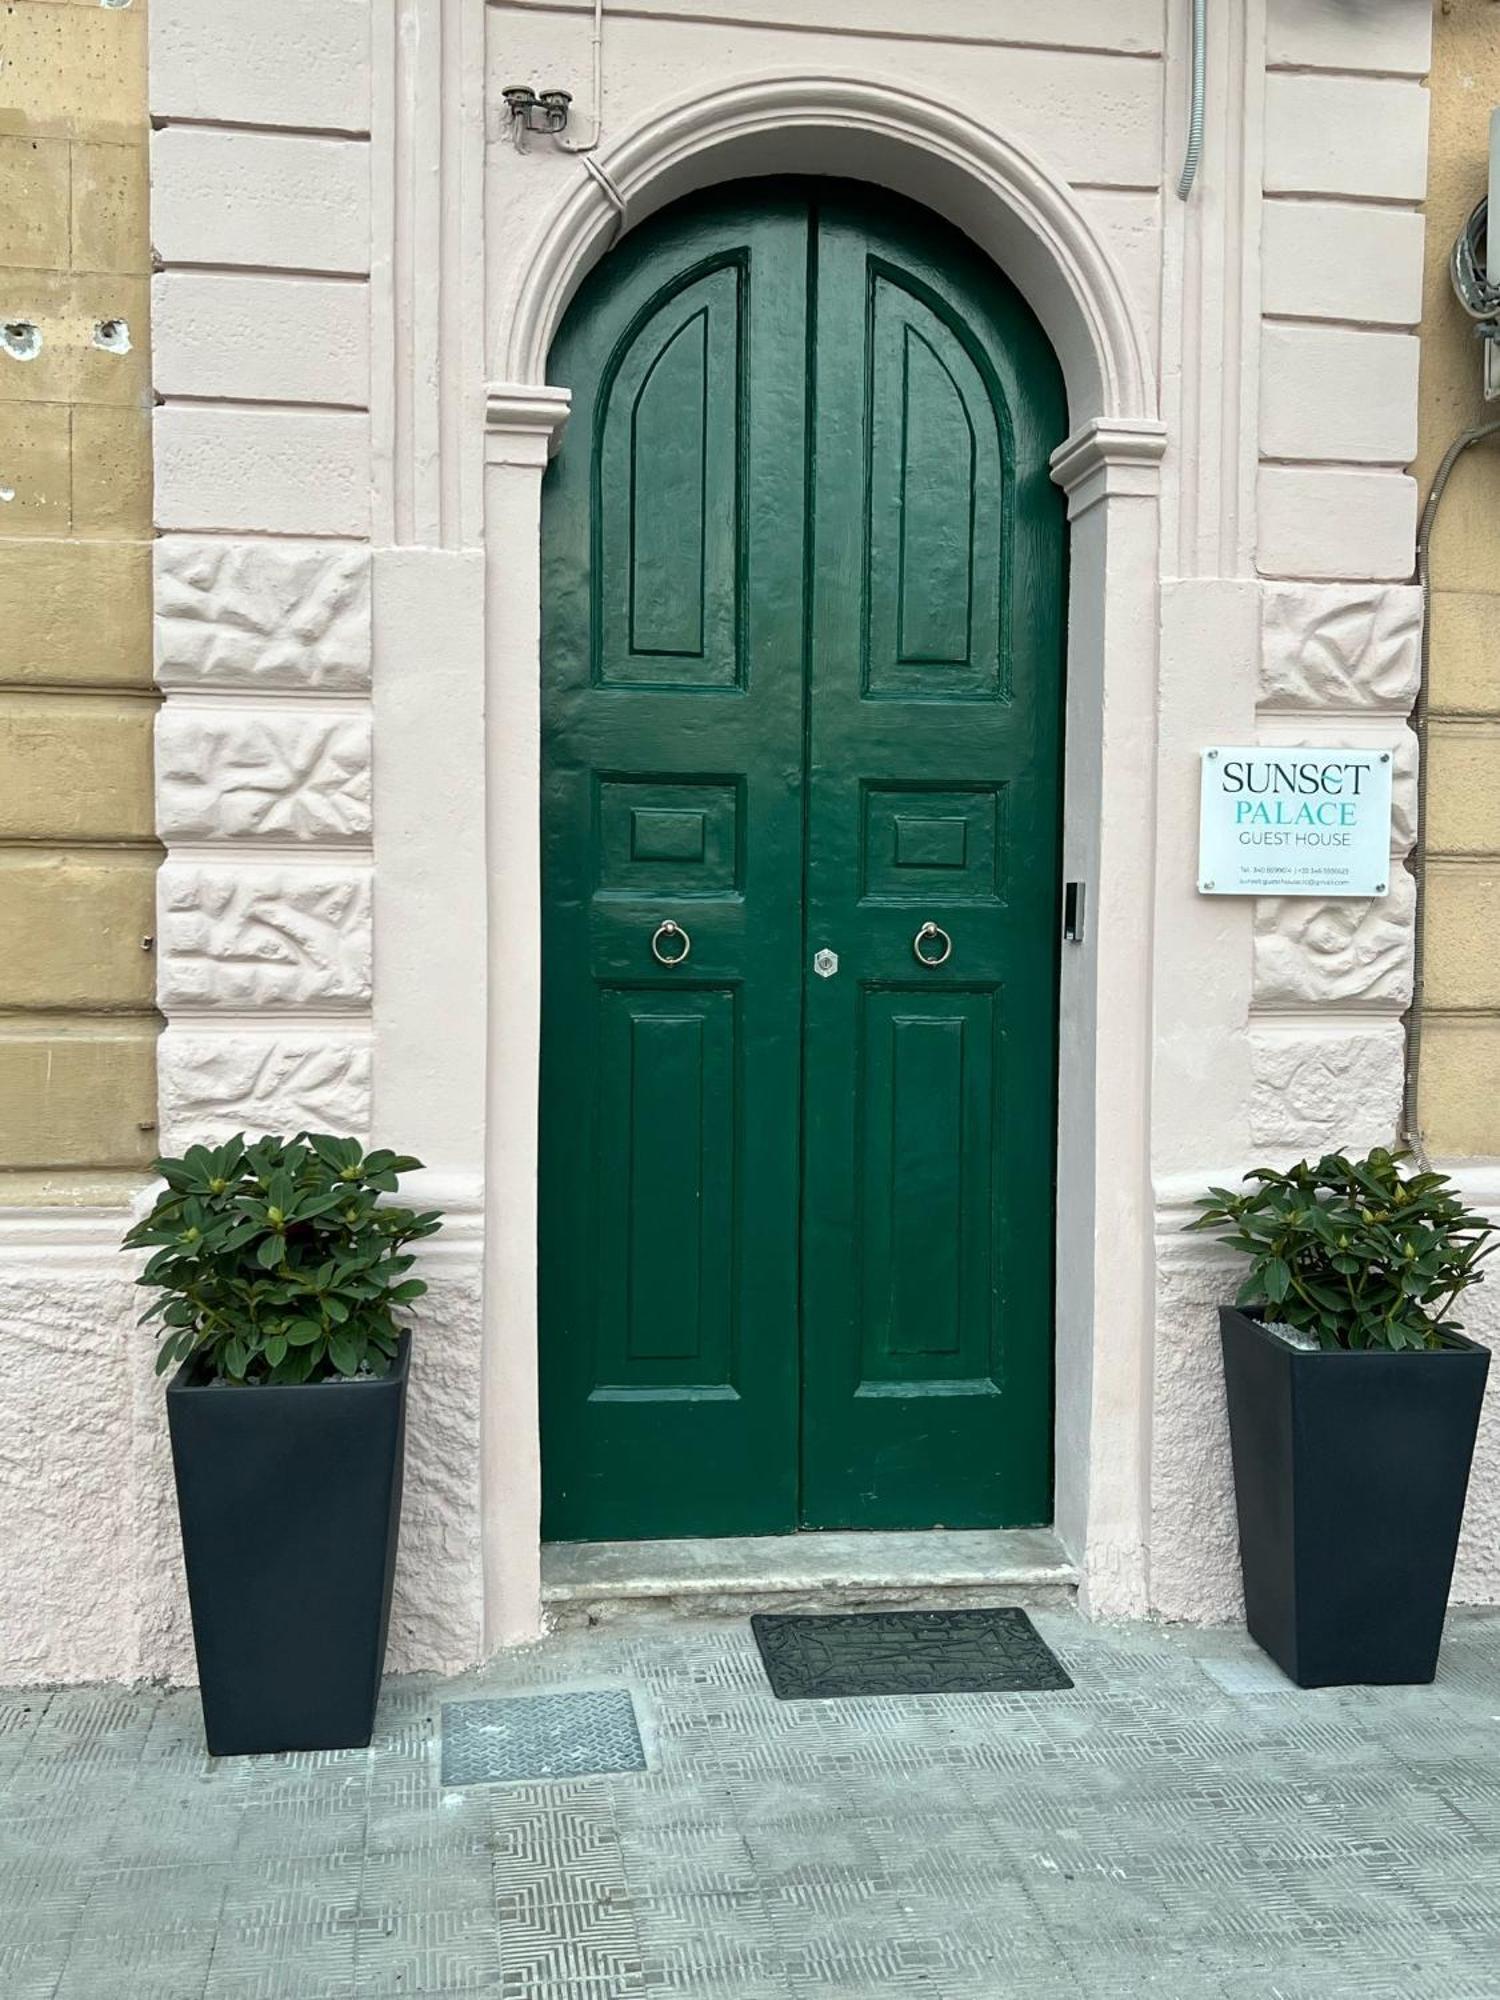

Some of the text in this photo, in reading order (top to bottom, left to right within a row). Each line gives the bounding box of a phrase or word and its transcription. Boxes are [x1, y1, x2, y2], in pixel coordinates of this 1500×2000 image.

[1222, 762, 1370, 795] SUNSET
[1236, 801, 1357, 826] PALACE
[1239, 831, 1352, 847] GUEST HOUSE
